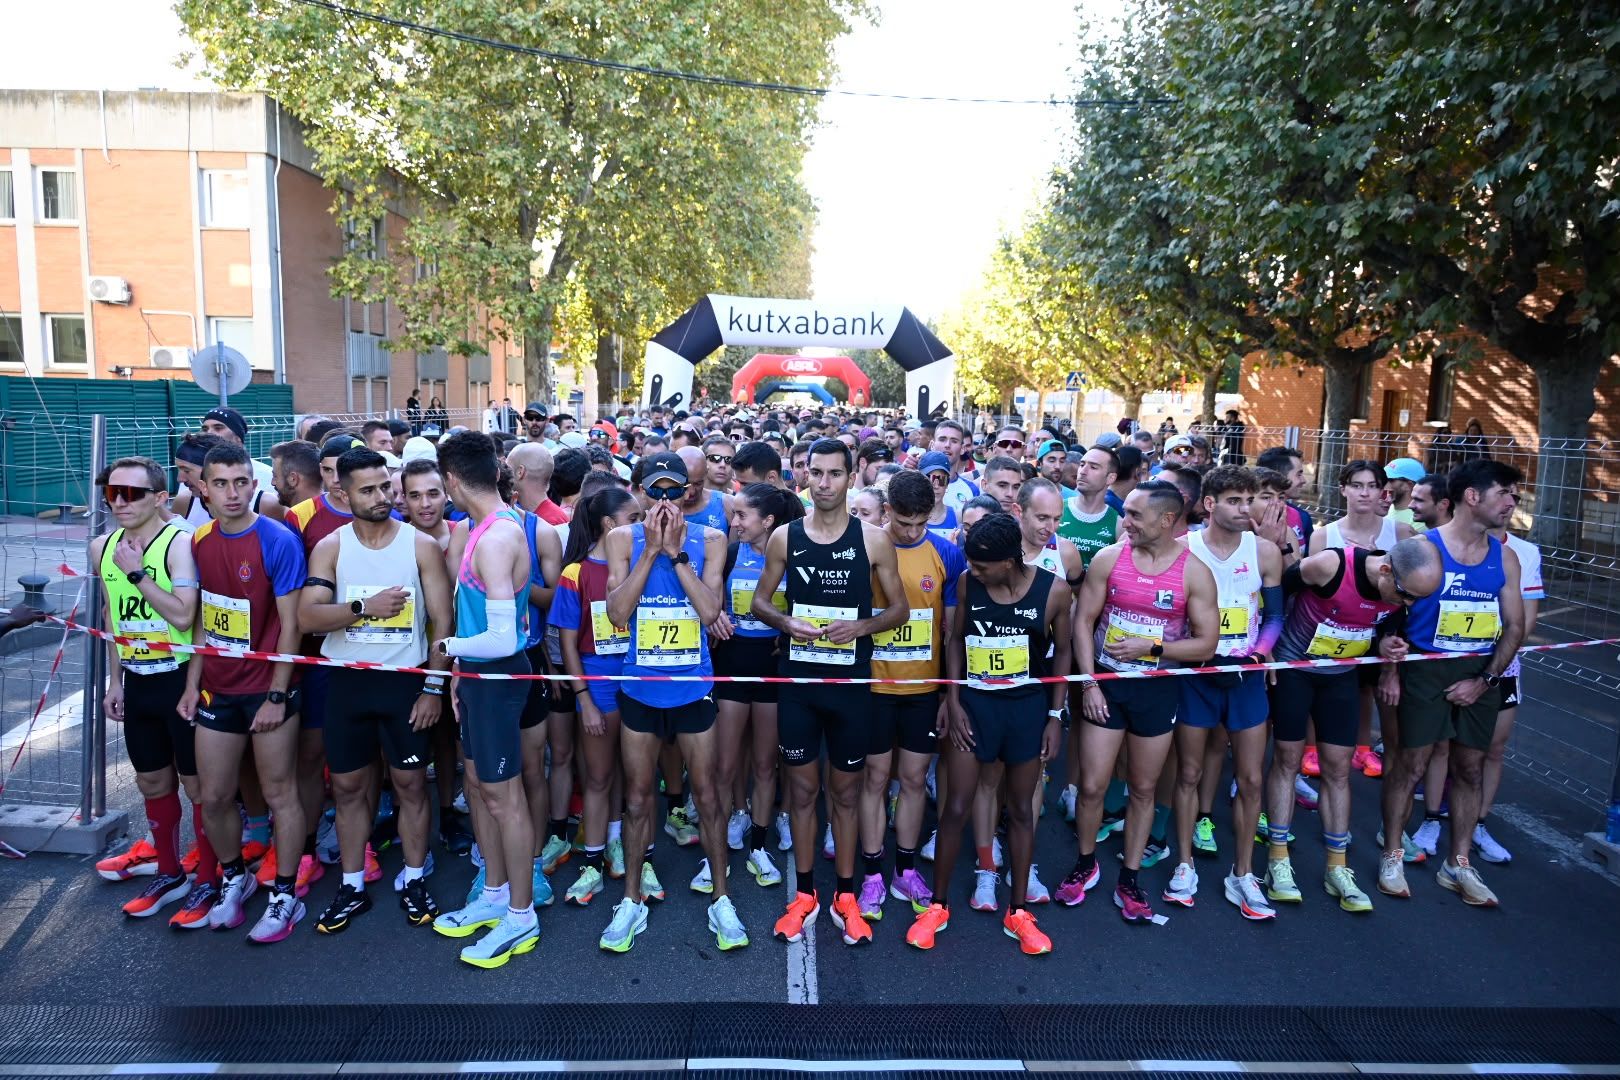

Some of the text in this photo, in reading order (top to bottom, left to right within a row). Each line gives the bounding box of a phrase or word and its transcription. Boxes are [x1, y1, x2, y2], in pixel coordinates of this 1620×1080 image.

[729, 305, 884, 336] kutxabank
[832, 547, 856, 560] be plus
[818, 570, 851, 579] VICKY
[214, 611, 230, 631] 48
[994, 625, 1026, 634] VICKY
[1465, 616, 1474, 633] 7
[659, 625, 679, 645] 72
[892, 625, 912, 642] 30
[1333, 643, 1347, 655] 5
[988, 653, 1005, 671] 15
